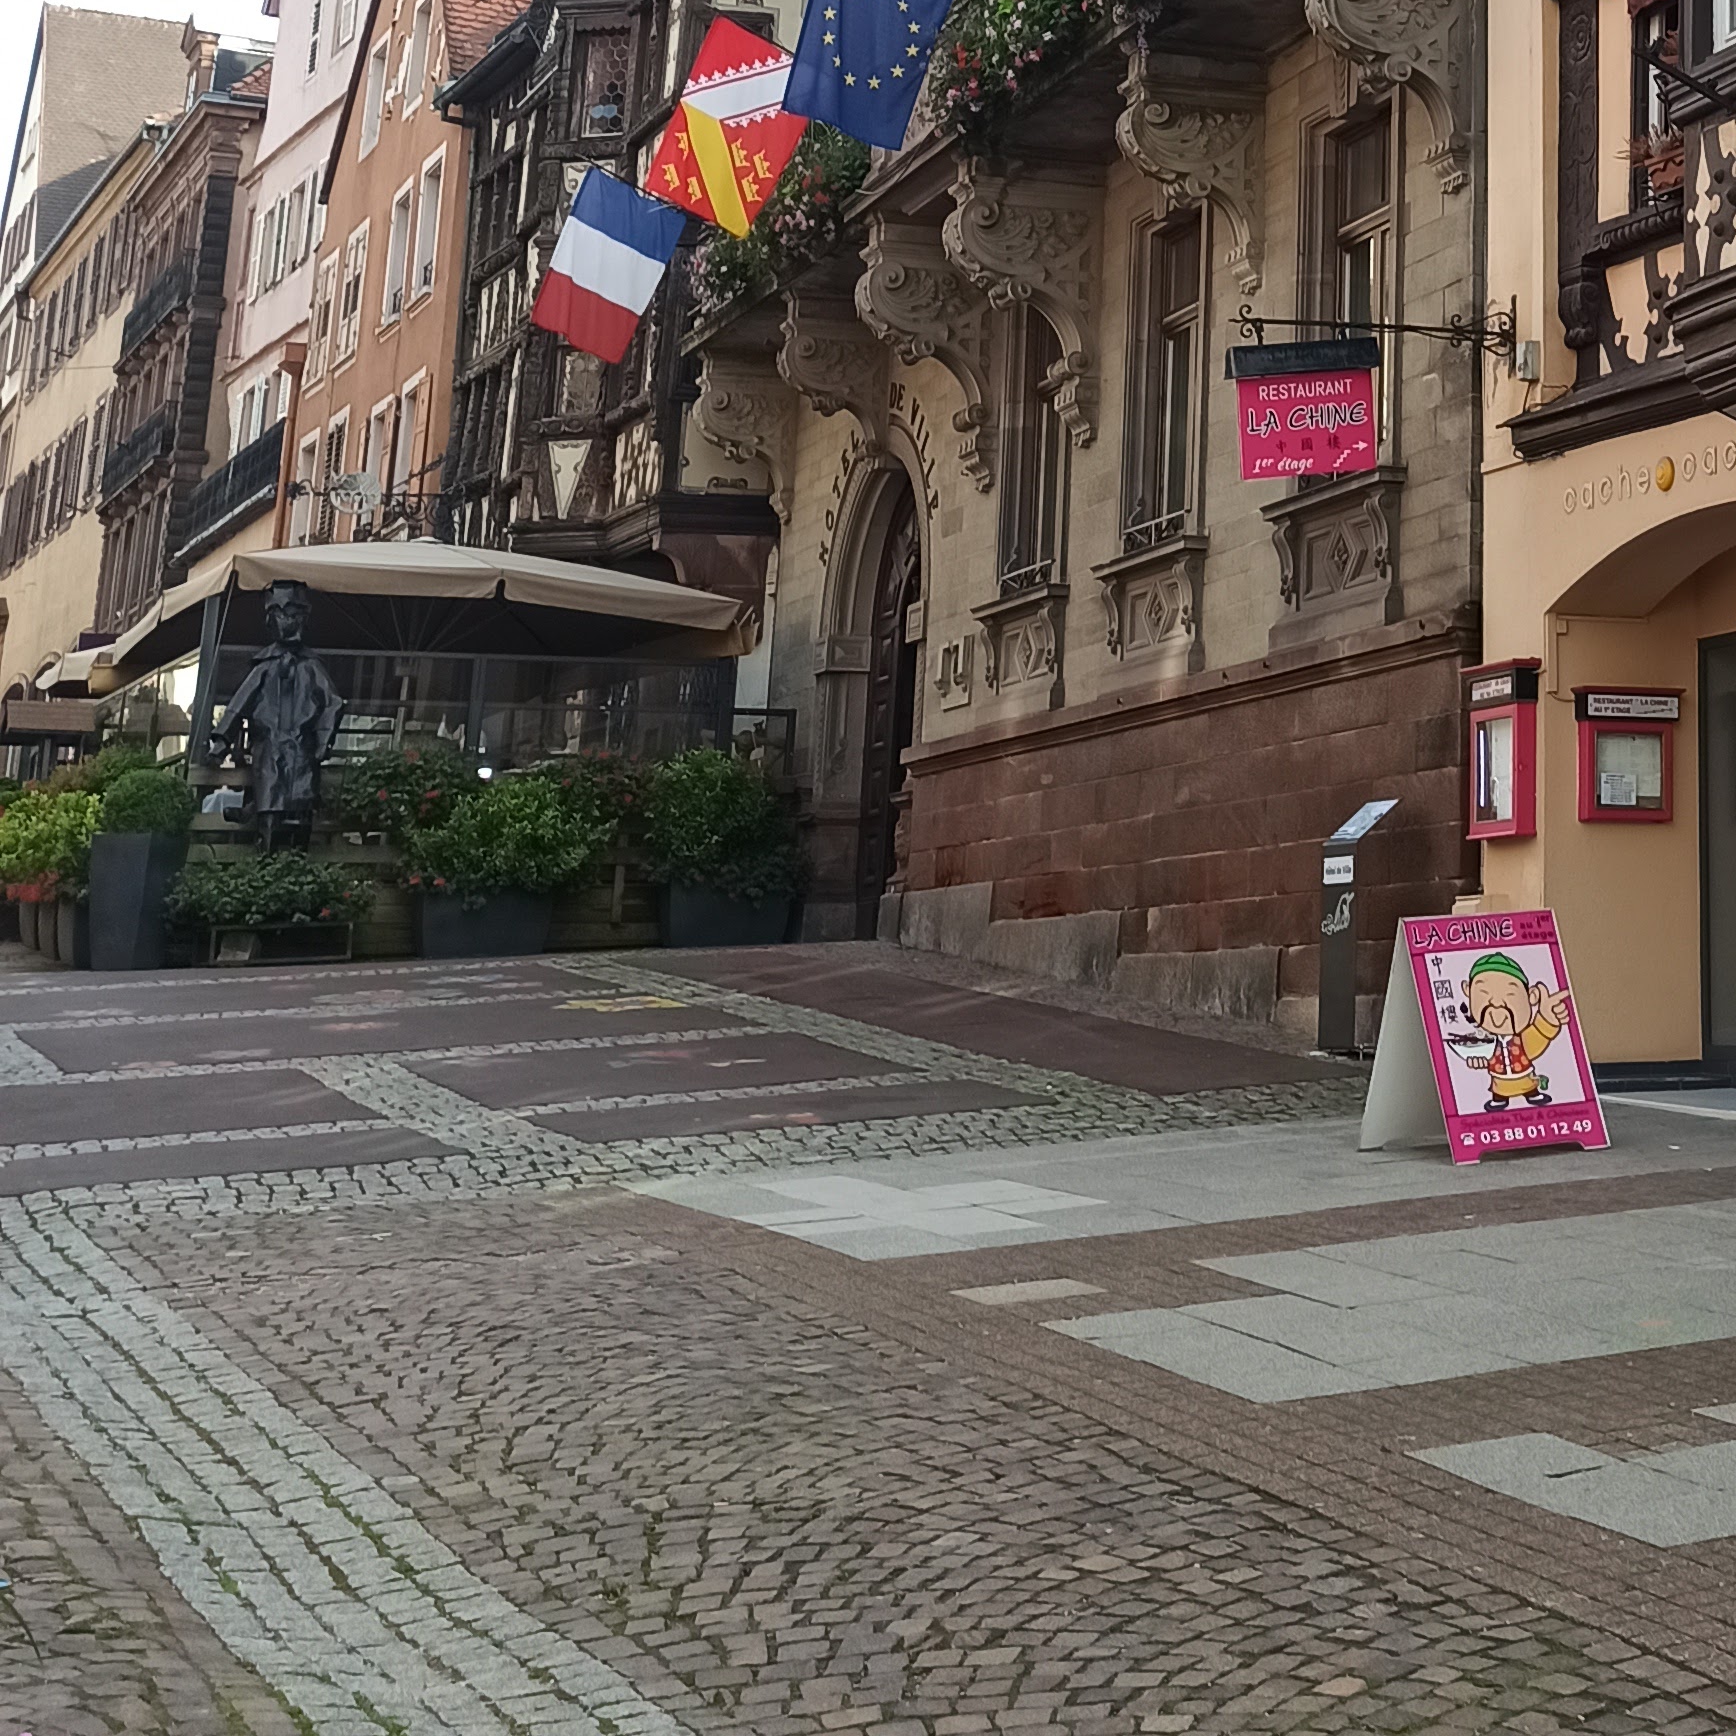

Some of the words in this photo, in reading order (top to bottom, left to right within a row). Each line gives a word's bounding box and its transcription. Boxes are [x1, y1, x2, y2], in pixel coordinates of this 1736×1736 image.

[1259, 379, 1352, 401] RESTAURANT
[1247, 407, 1281, 438] LA
[1287, 400, 1368, 433] CHINE
[889, 382, 905, 411] DE
[911, 397, 939, 520] VILLE
[1253, 458, 1274, 473] 1er
[1277, 457, 1314, 474] étage
[1411, 923, 1445, 949] LA
[1447, 917, 1516, 945] CHINE
[1480, 1130, 1500, 1144] 03
[1504, 1127, 1524, 1141] 88
[1527, 1124, 1546, 1138] 01
[1551, 1122, 1570, 1135] 12
[1573, 1119, 1592, 1133] 49
